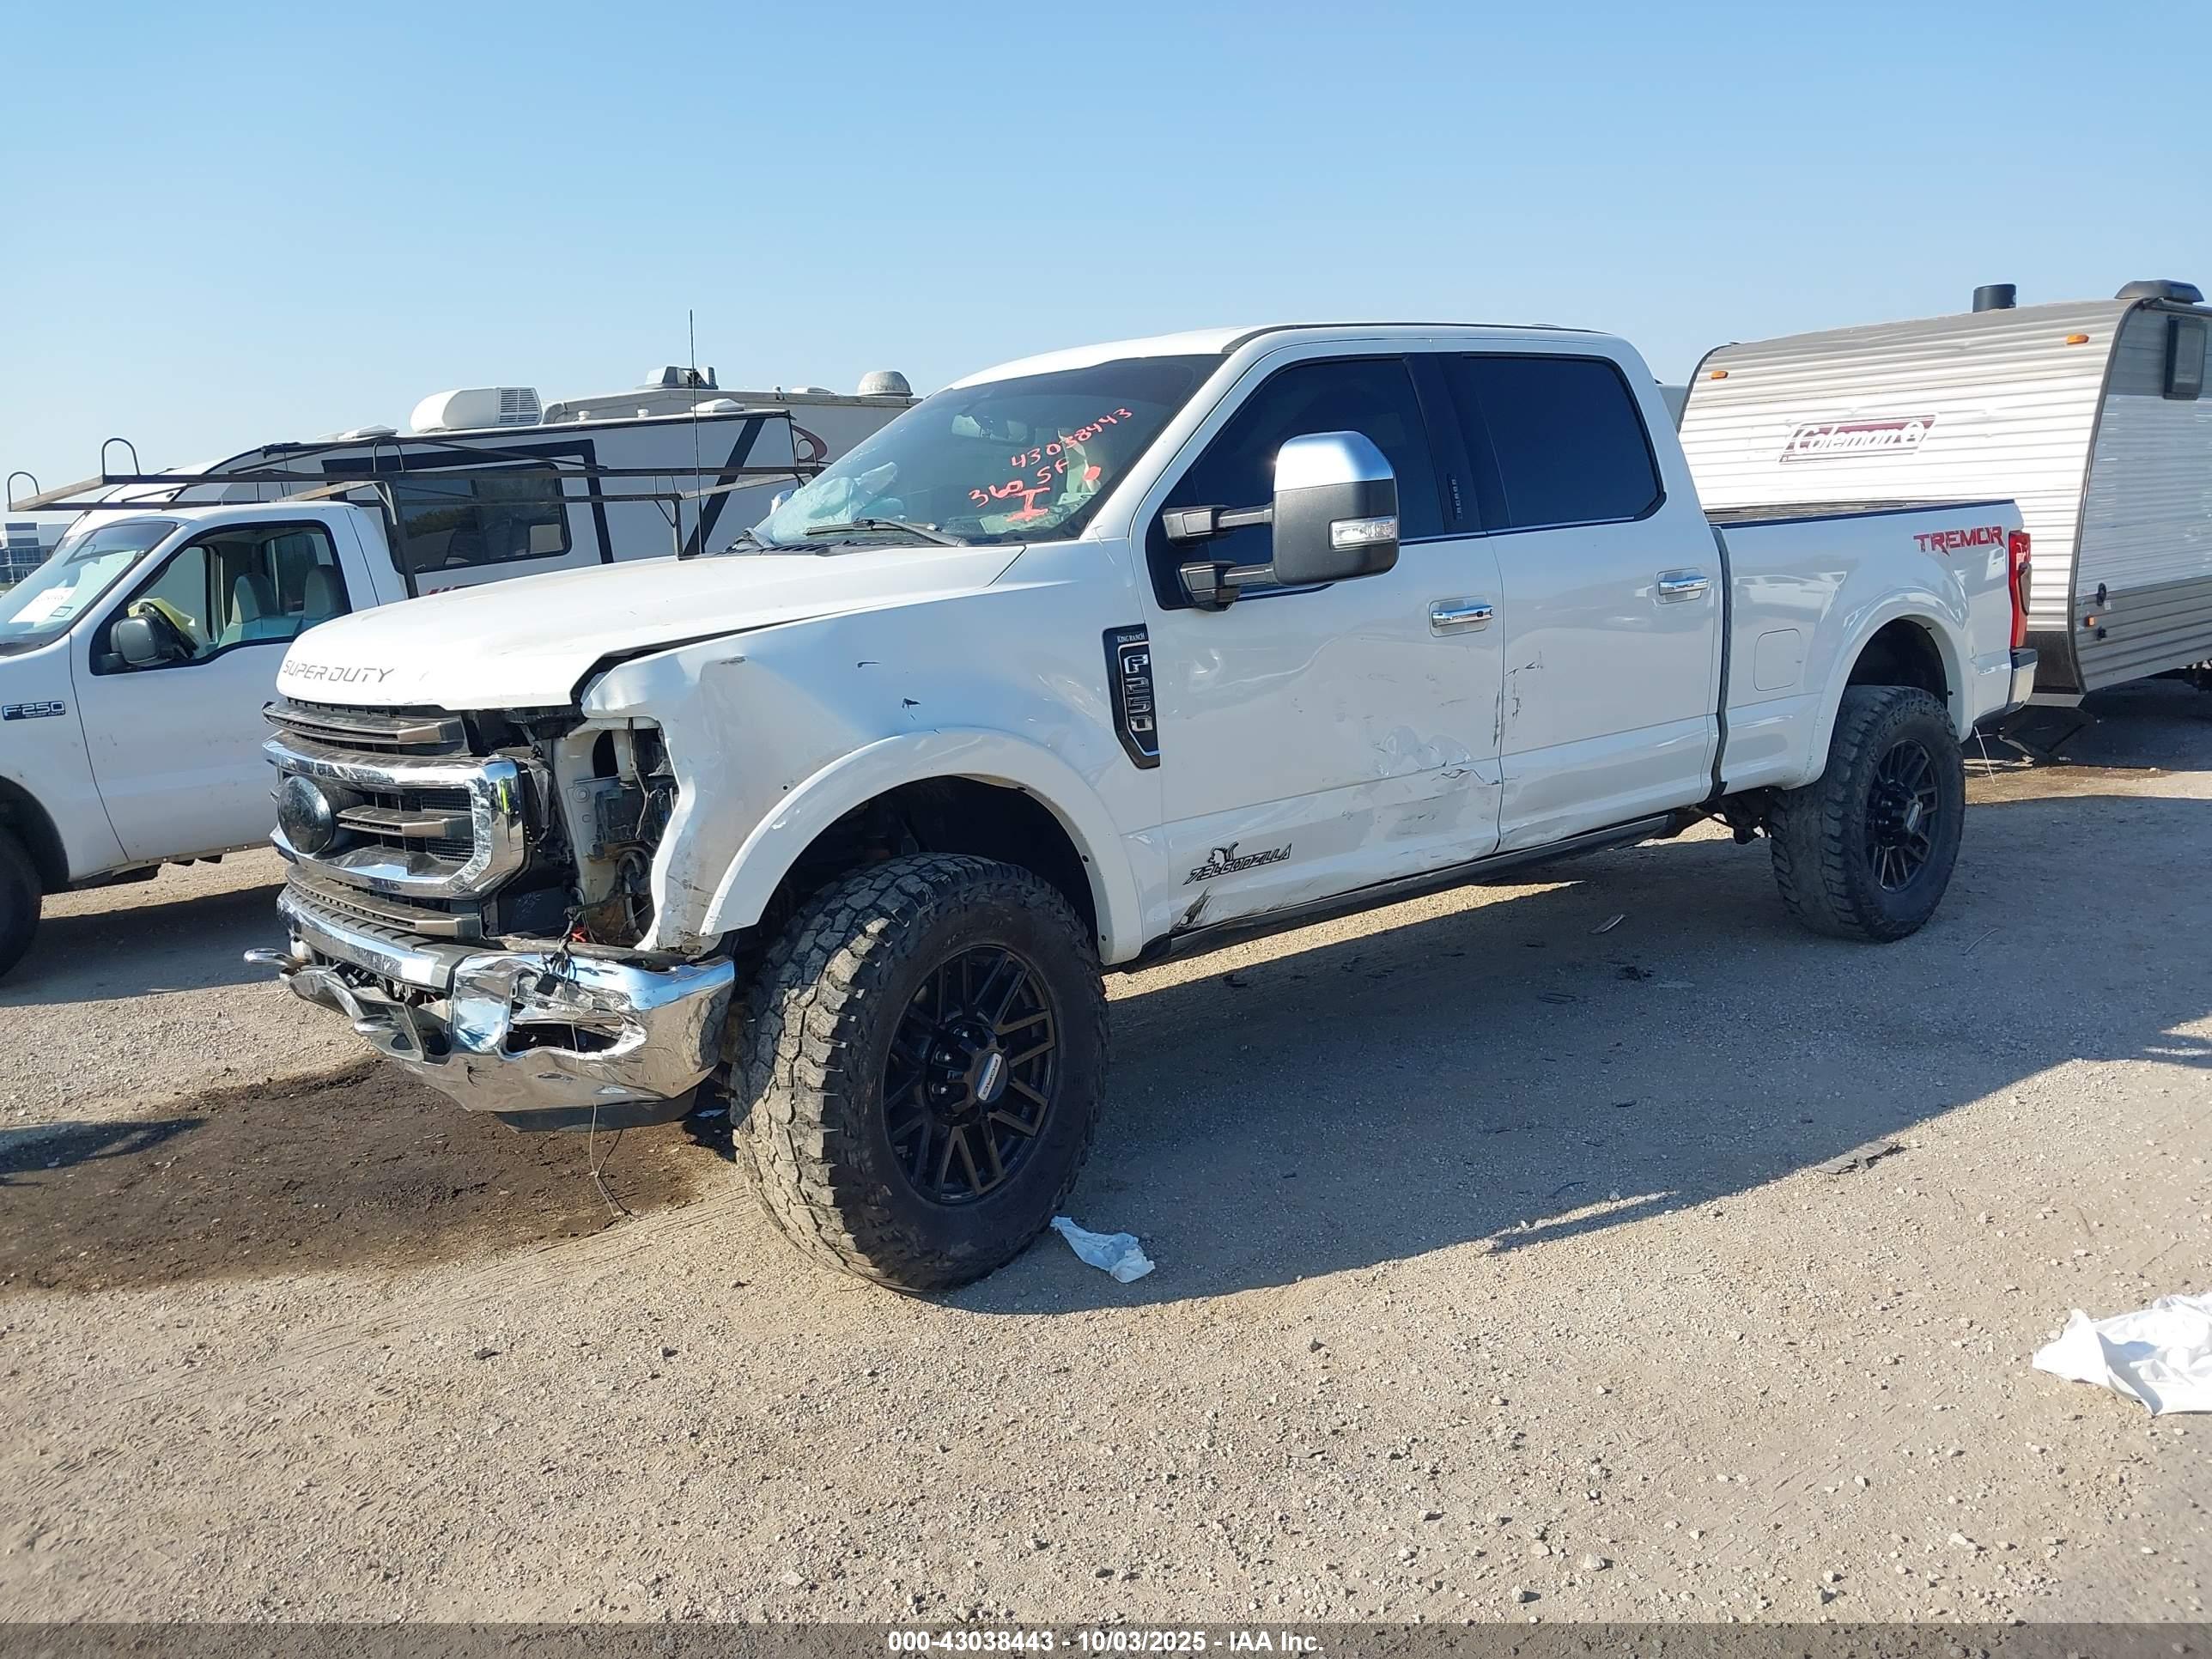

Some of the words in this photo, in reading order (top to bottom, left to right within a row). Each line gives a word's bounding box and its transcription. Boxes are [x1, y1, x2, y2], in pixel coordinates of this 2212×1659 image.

[1011, 407, 1133, 469] 43038443
[1793, 424, 1901, 454] Coleman
[1913, 526, 2006, 556] TREMOR
[283, 659, 328, 681] SUPER
[328, 667, 394, 683] DUTY
[3, 702, 65, 717] F-250
[1220, 843, 1291, 874] GODZILLA
